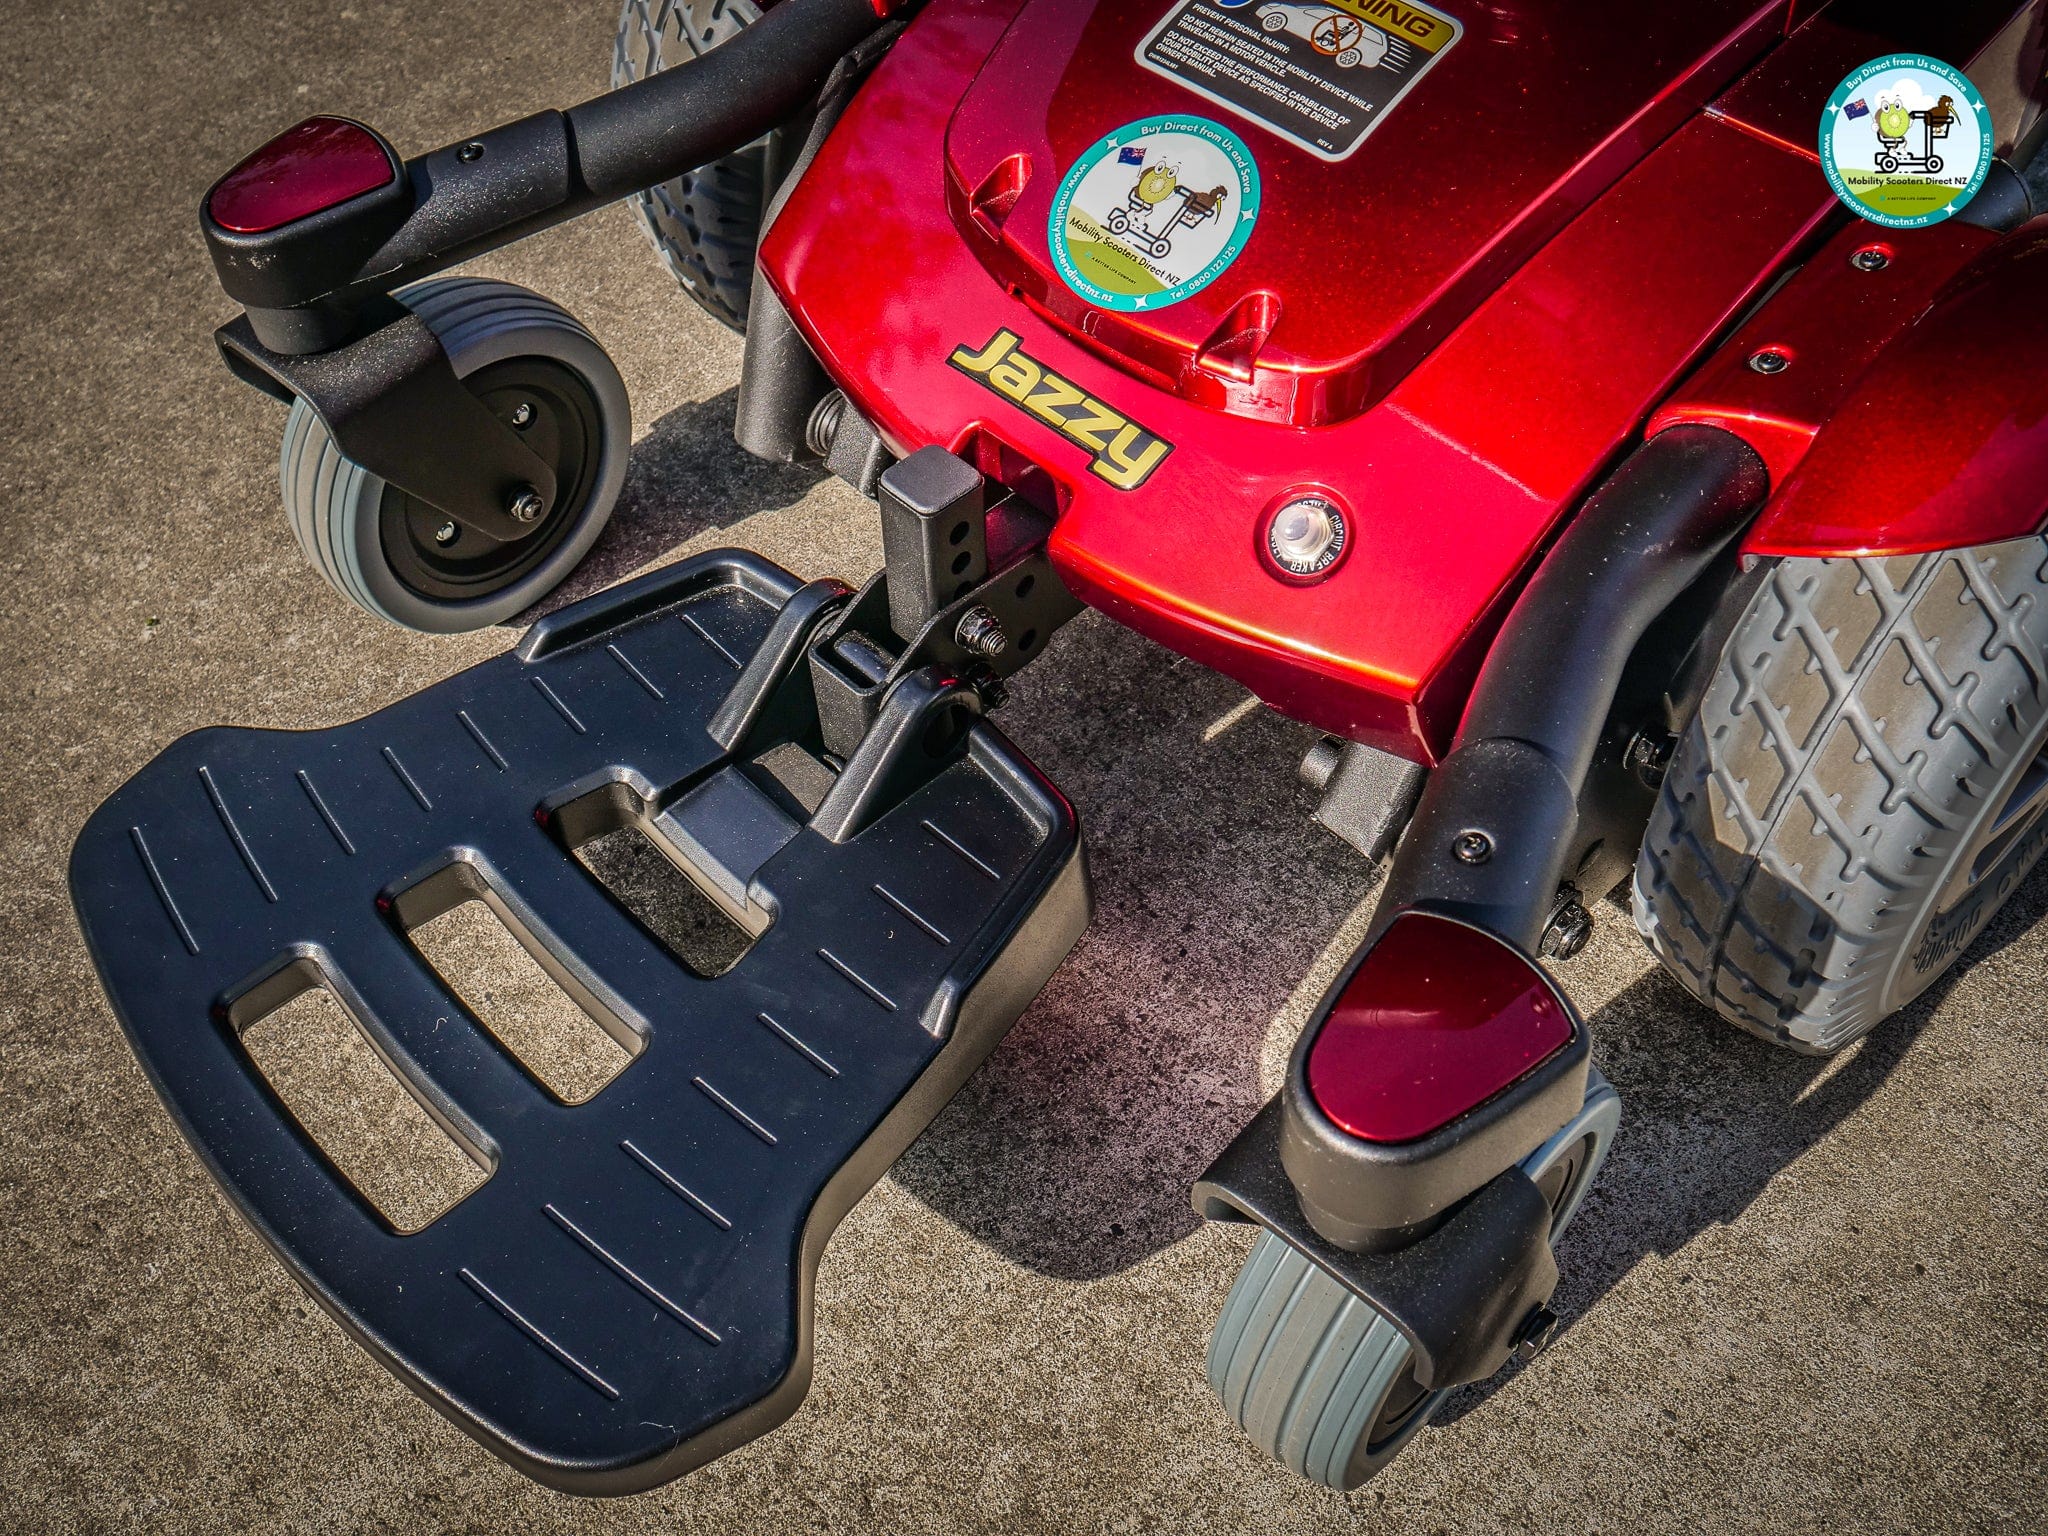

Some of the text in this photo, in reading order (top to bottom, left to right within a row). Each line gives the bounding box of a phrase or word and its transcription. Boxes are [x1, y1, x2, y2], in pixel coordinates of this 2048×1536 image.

[1155, 43, 1188, 62] OWNER'S
[1177, 20, 1216, 41] TRAVELING
[1214, 38, 1225, 46] IN
[1229, 44, 1257, 62] MOTOR
[1192, 3, 1225, 22] PREVENT
[1224, 18, 1263, 40] PERSONAL
[1161, 37, 1182, 49] YOUR
[1180, 44, 1215, 66] MOBILITY
[1212, 61, 1240, 78] DEVICE
[1238, 75, 1250, 84] AS
[1249, 80, 1288, 103] SPECIFIED
[1285, 99, 1296, 109] IN
[1294, 102, 1311, 116] THE
[1309, 111, 1339, 130] DEVICE
[1166, 30, 1180, 40] DO
[1178, 36, 1196, 46] NOT
[1192, 42, 1223, 61] EXCEED
[1219, 55, 1237, 67] THE
[1235, 62, 1291, 94] PERFORMANCE
[1288, 90, 1339, 120] CAPABILITIES
[1337, 115, 1351, 125] OF
[1182, 14, 1374, 112] DO NOT REMAIN SEATED IN THE MOBILITY DEVICE WHILE
[1141, 122, 1251, 193] Buy Direct from Us and Save
[1052, 163, 1114, 303] www.mobilityscootersdirectnz.nz
[1069, 217, 1181, 286] Mobility Scooters Direct NZ
[1170, 245, 1236, 300] Tel: 0800 122 125
[951, 331, 1168, 489] Jazzy
[1290, 551, 1335, 573] BREAKER
